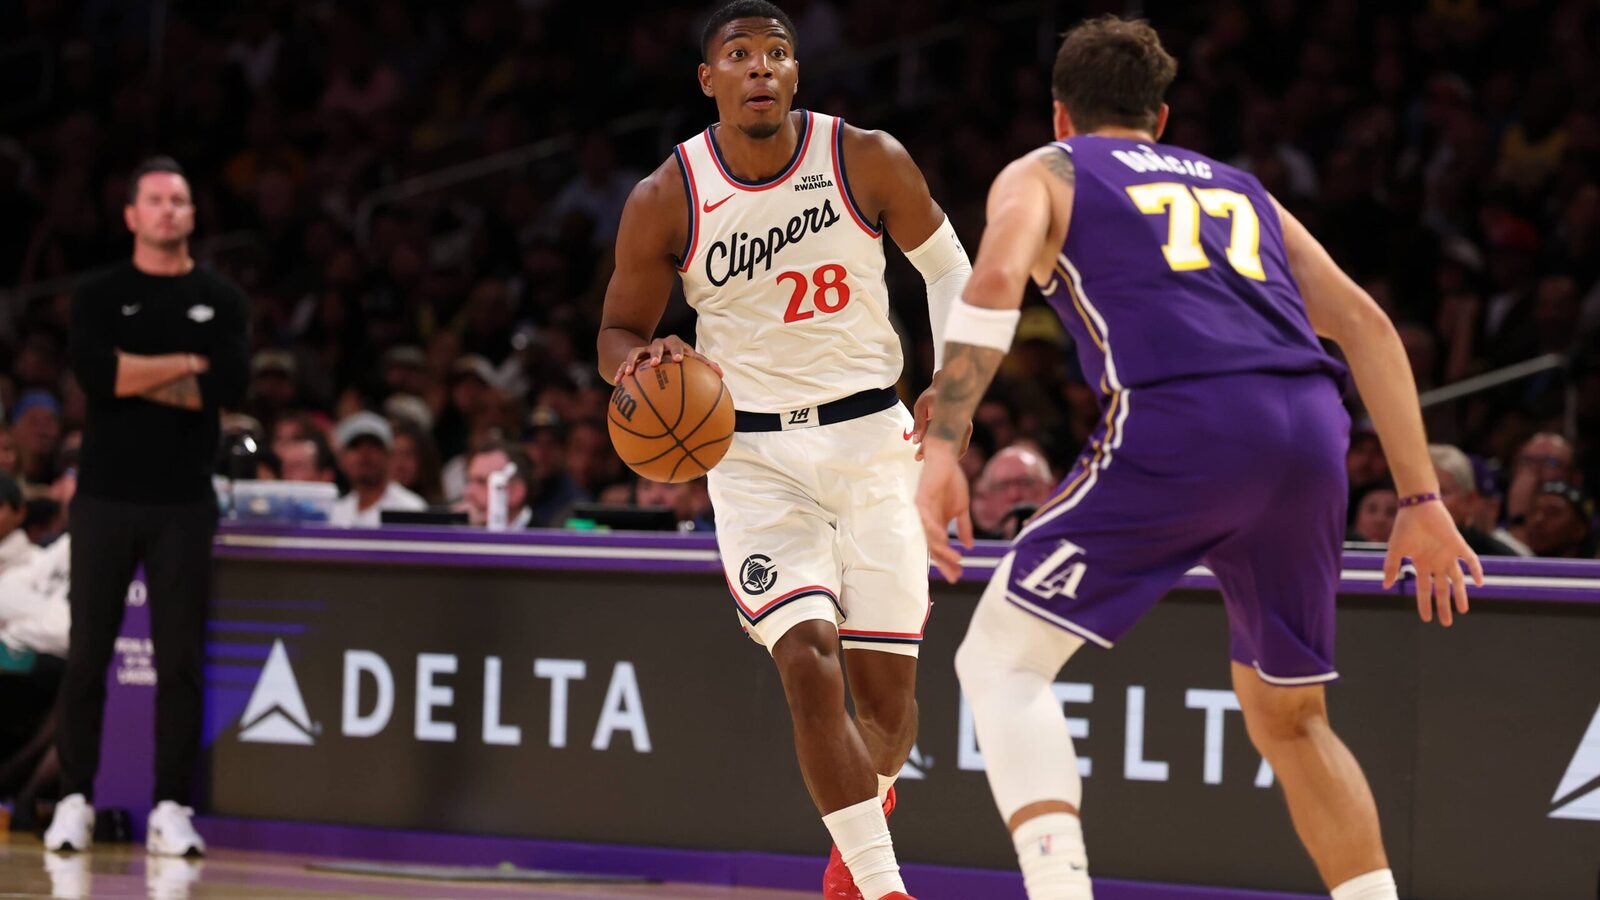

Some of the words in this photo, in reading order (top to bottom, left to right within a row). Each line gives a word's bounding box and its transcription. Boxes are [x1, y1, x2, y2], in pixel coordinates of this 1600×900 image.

[794, 180, 833, 191] RWANDA
[801, 174, 824, 183] VISIT
[705, 199, 840, 287] Clippers
[1125, 182, 1267, 282] 77
[776, 264, 850, 323] 28
[1015, 538, 1087, 600] LA
[342, 649, 651, 753] DELTA
